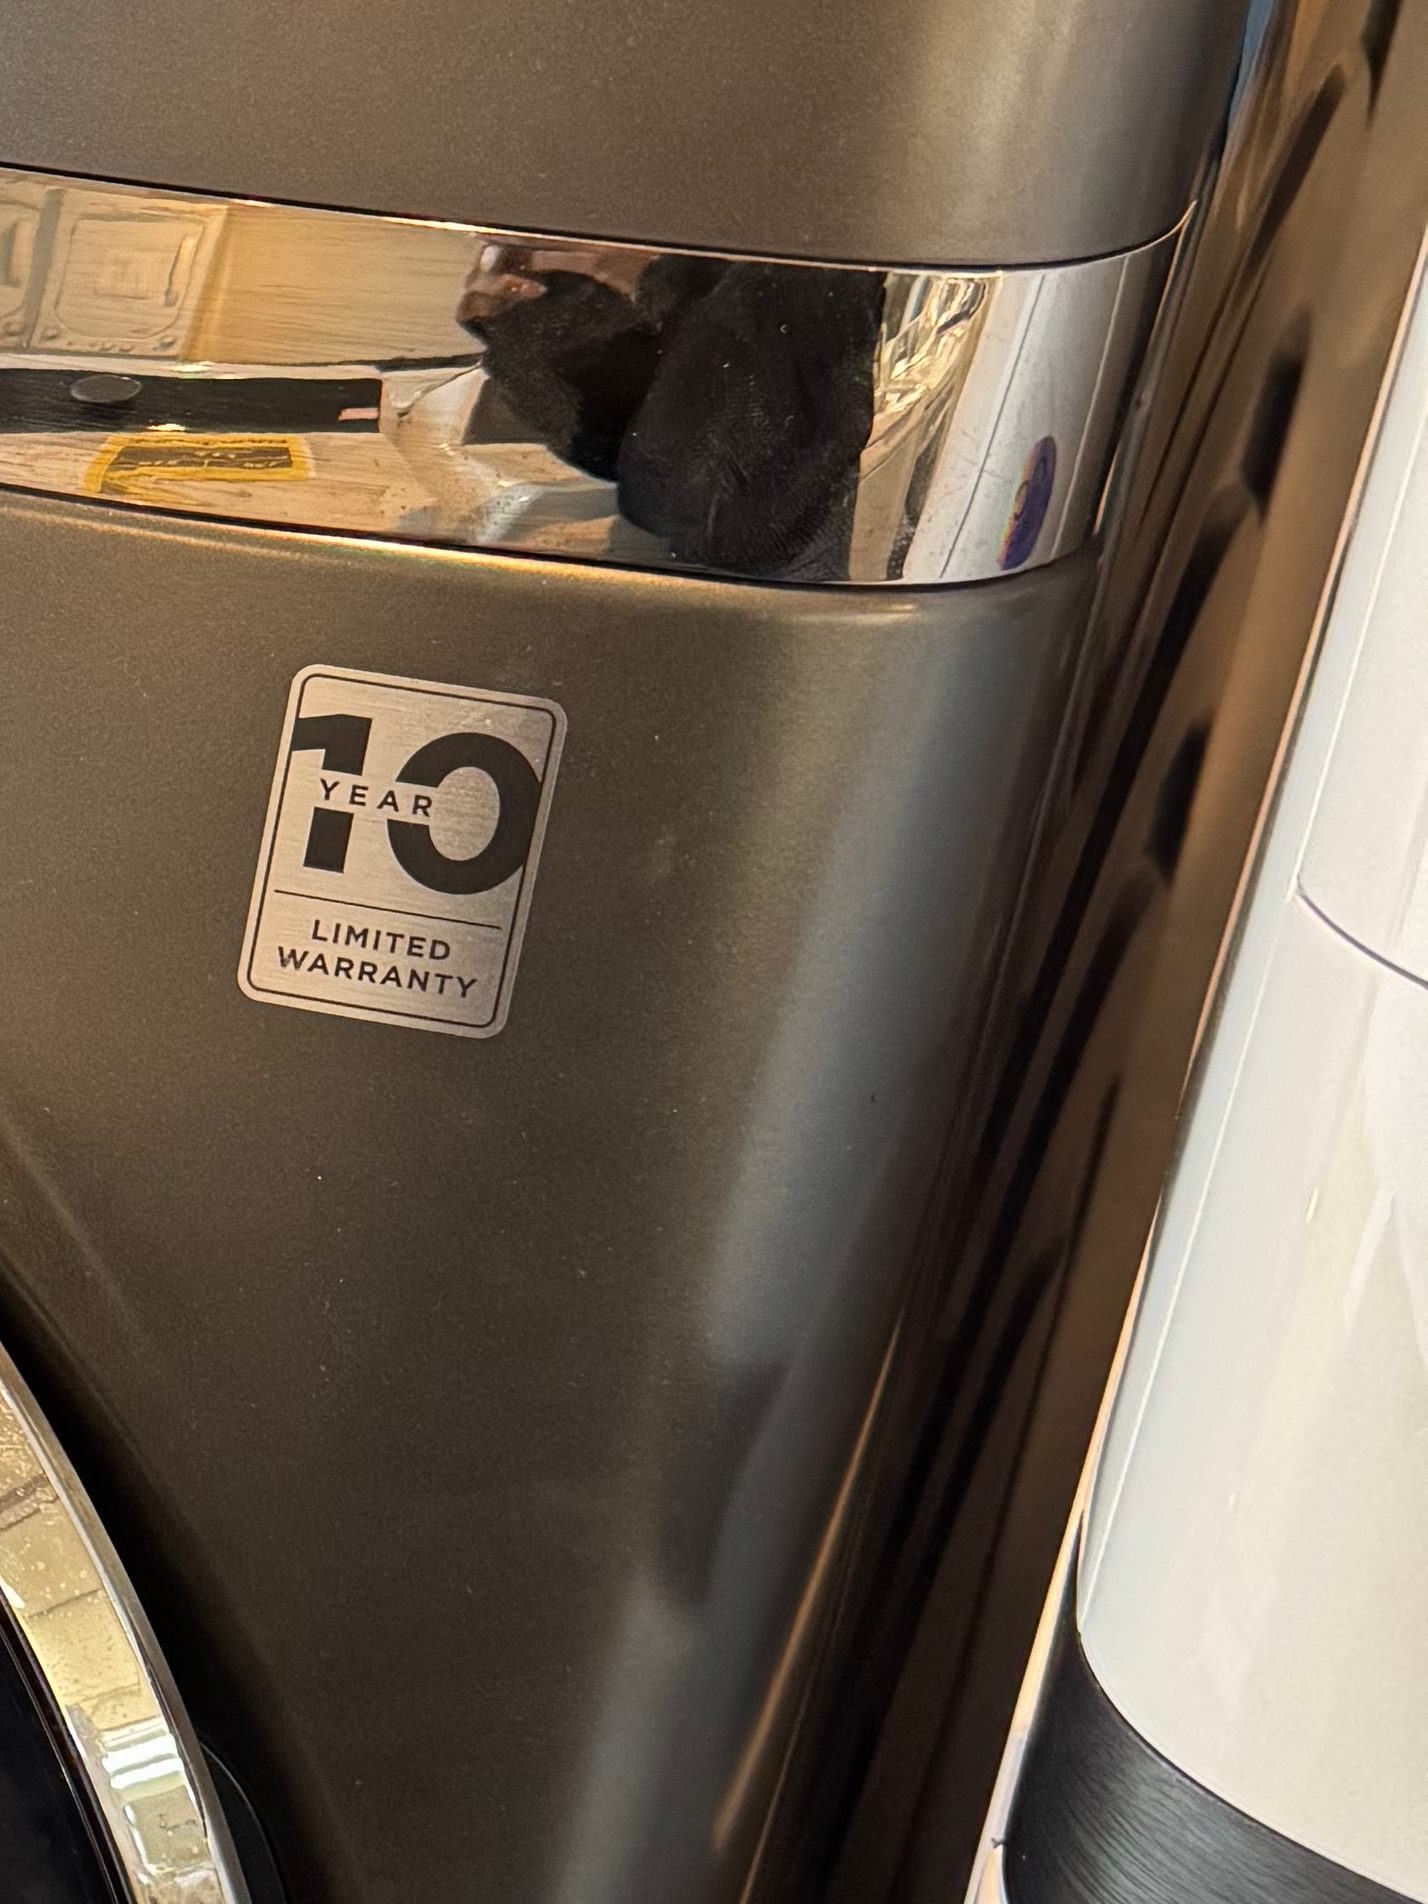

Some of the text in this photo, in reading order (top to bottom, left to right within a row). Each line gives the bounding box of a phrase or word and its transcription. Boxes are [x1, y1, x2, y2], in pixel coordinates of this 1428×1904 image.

[291, 713, 542, 895] 10
[320, 778, 432, 817] YEAR
[312, 919, 451, 961] LIMITED
[277, 946, 478, 999] WARRANTY
